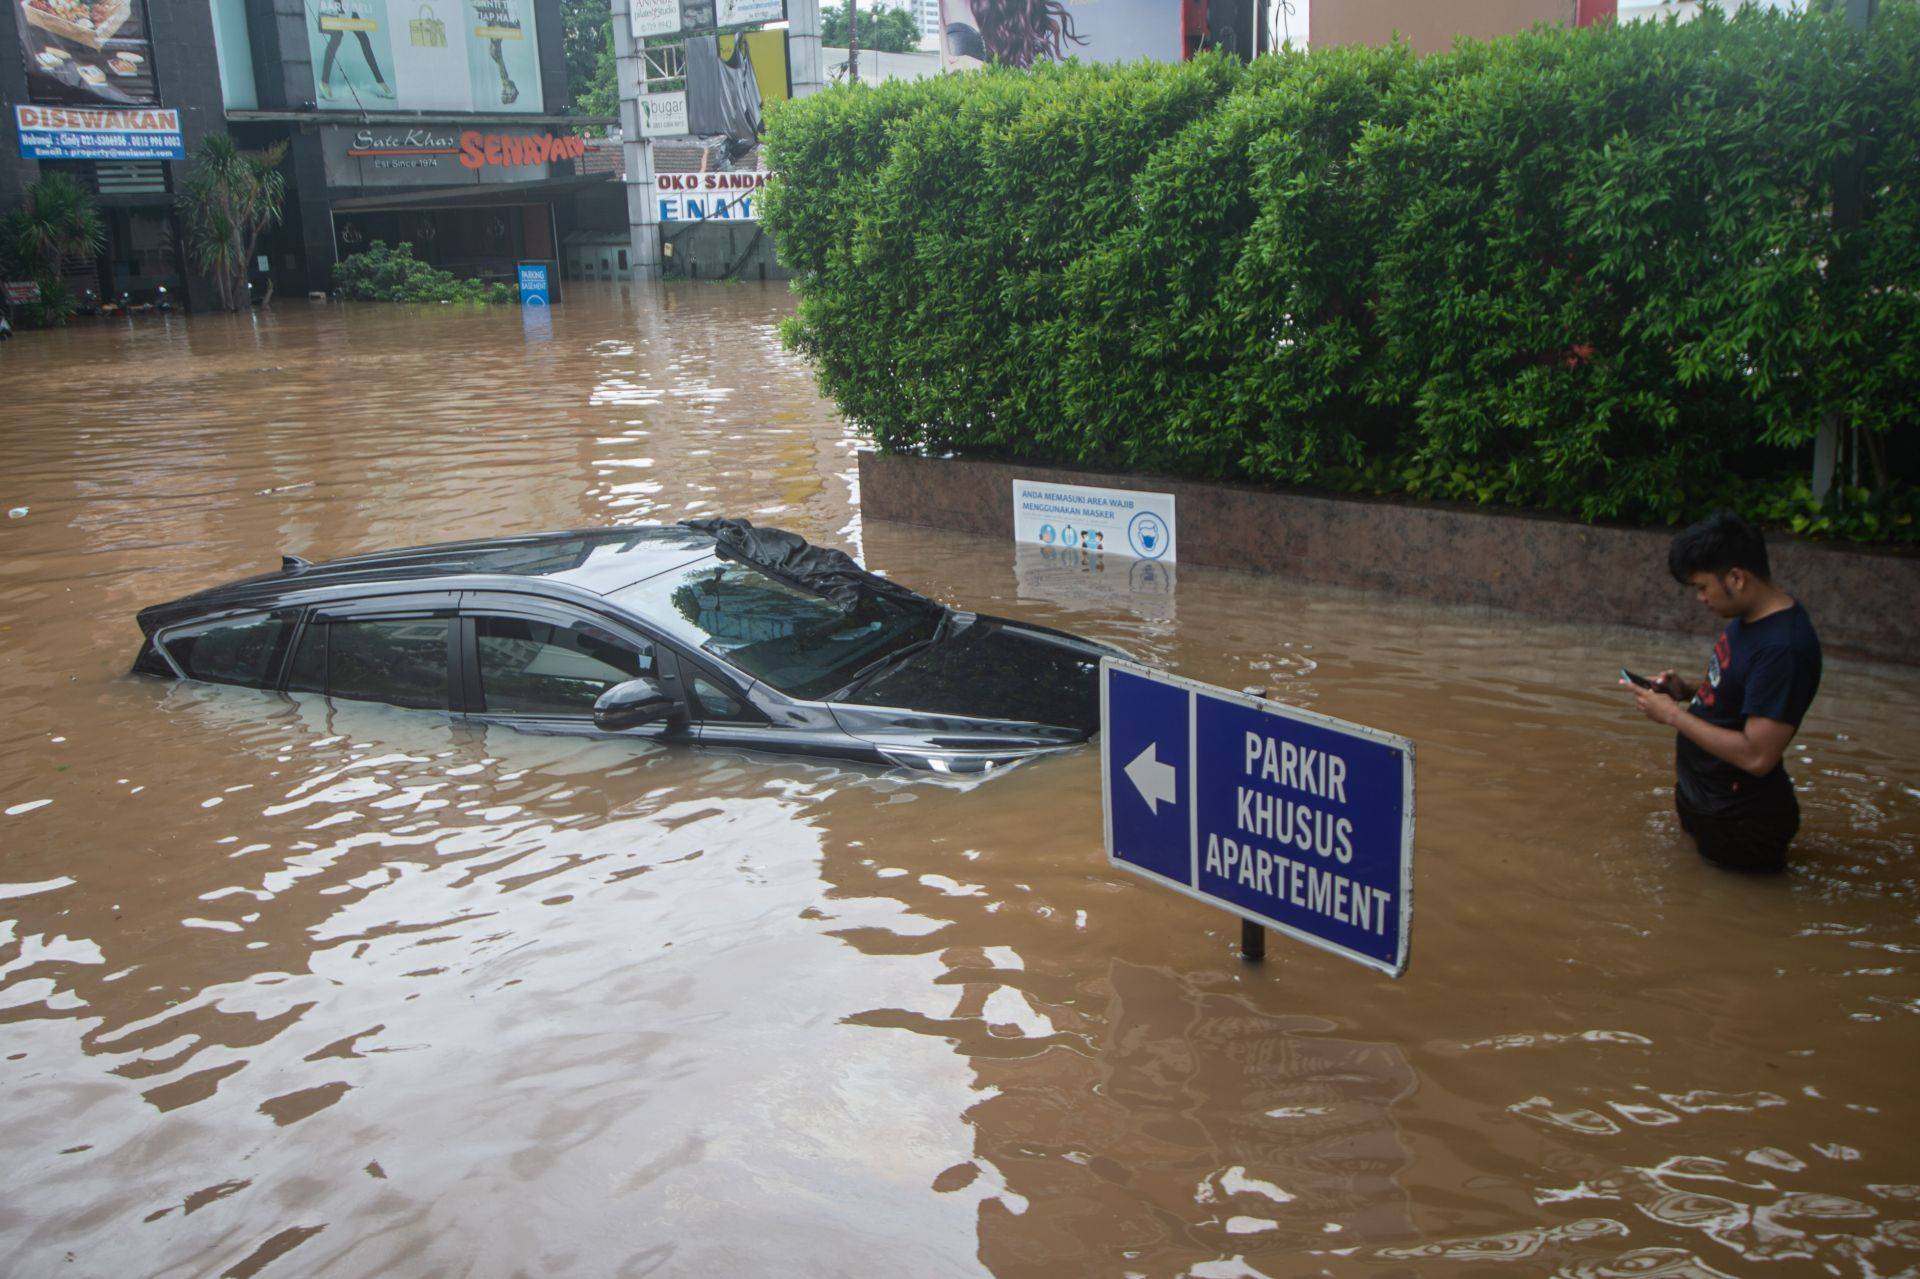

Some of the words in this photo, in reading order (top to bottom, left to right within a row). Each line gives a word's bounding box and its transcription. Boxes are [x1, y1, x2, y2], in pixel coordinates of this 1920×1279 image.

[651, 100, 683, 116] bugar
[353, 129, 400, 150] Sate
[404, 129, 455, 148] Khas
[460, 131, 584, 169] SENAYAN
[392, 160, 417, 168] Since
[420, 159, 438, 167] 1974
[656, 175, 699, 190] OKO
[521, 270, 545, 280] PARKING
[1022, 490, 1043, 500] ANDA
[1044, 492, 1085, 504] MEMASUKI
[1087, 497, 1108, 506] AREA
[1109, 499, 1135, 509] WAJIB
[1022, 502, 1081, 516] MENGGUNAKAN
[1082, 509, 1115, 520] MASKER
[1246, 731, 1346, 804] PARKIR
[1237, 786, 1353, 864] KHUSUS
[1206, 833, 1391, 935] APARTEMENT
